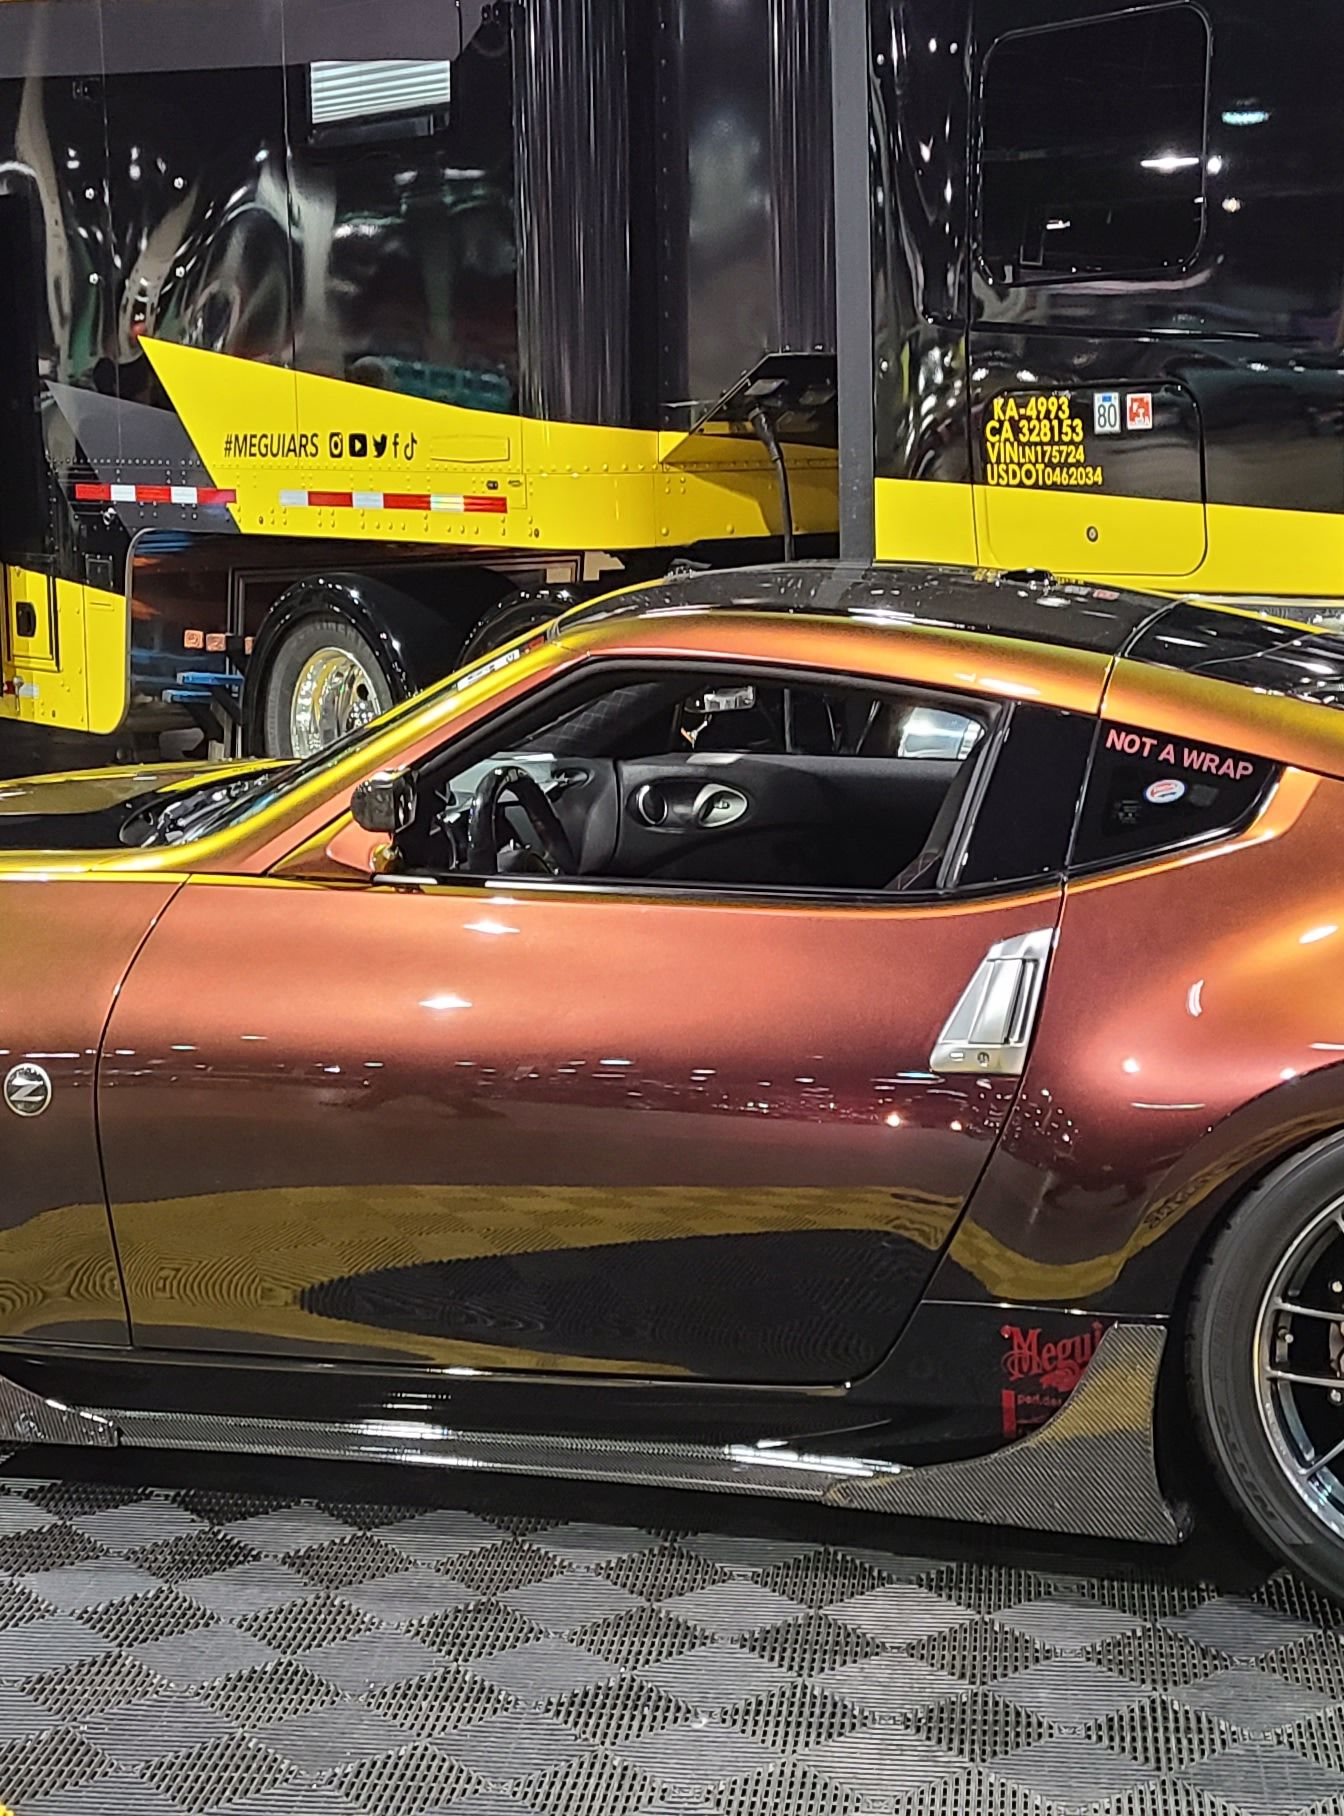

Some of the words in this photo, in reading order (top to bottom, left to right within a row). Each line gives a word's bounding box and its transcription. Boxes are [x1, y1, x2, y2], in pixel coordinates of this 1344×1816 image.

[993, 396, 1070, 420] KA-4993
[1097, 404, 1117, 428] 80
[985, 421, 1014, 442] CA
[1018, 419, 1084, 442] 328153
[223, 432, 320, 459] #MEGUIARS
[1105, 728, 1158, 758] NOT
[1158, 743, 1176, 765] A
[1182, 747, 1255, 781] WRAP
